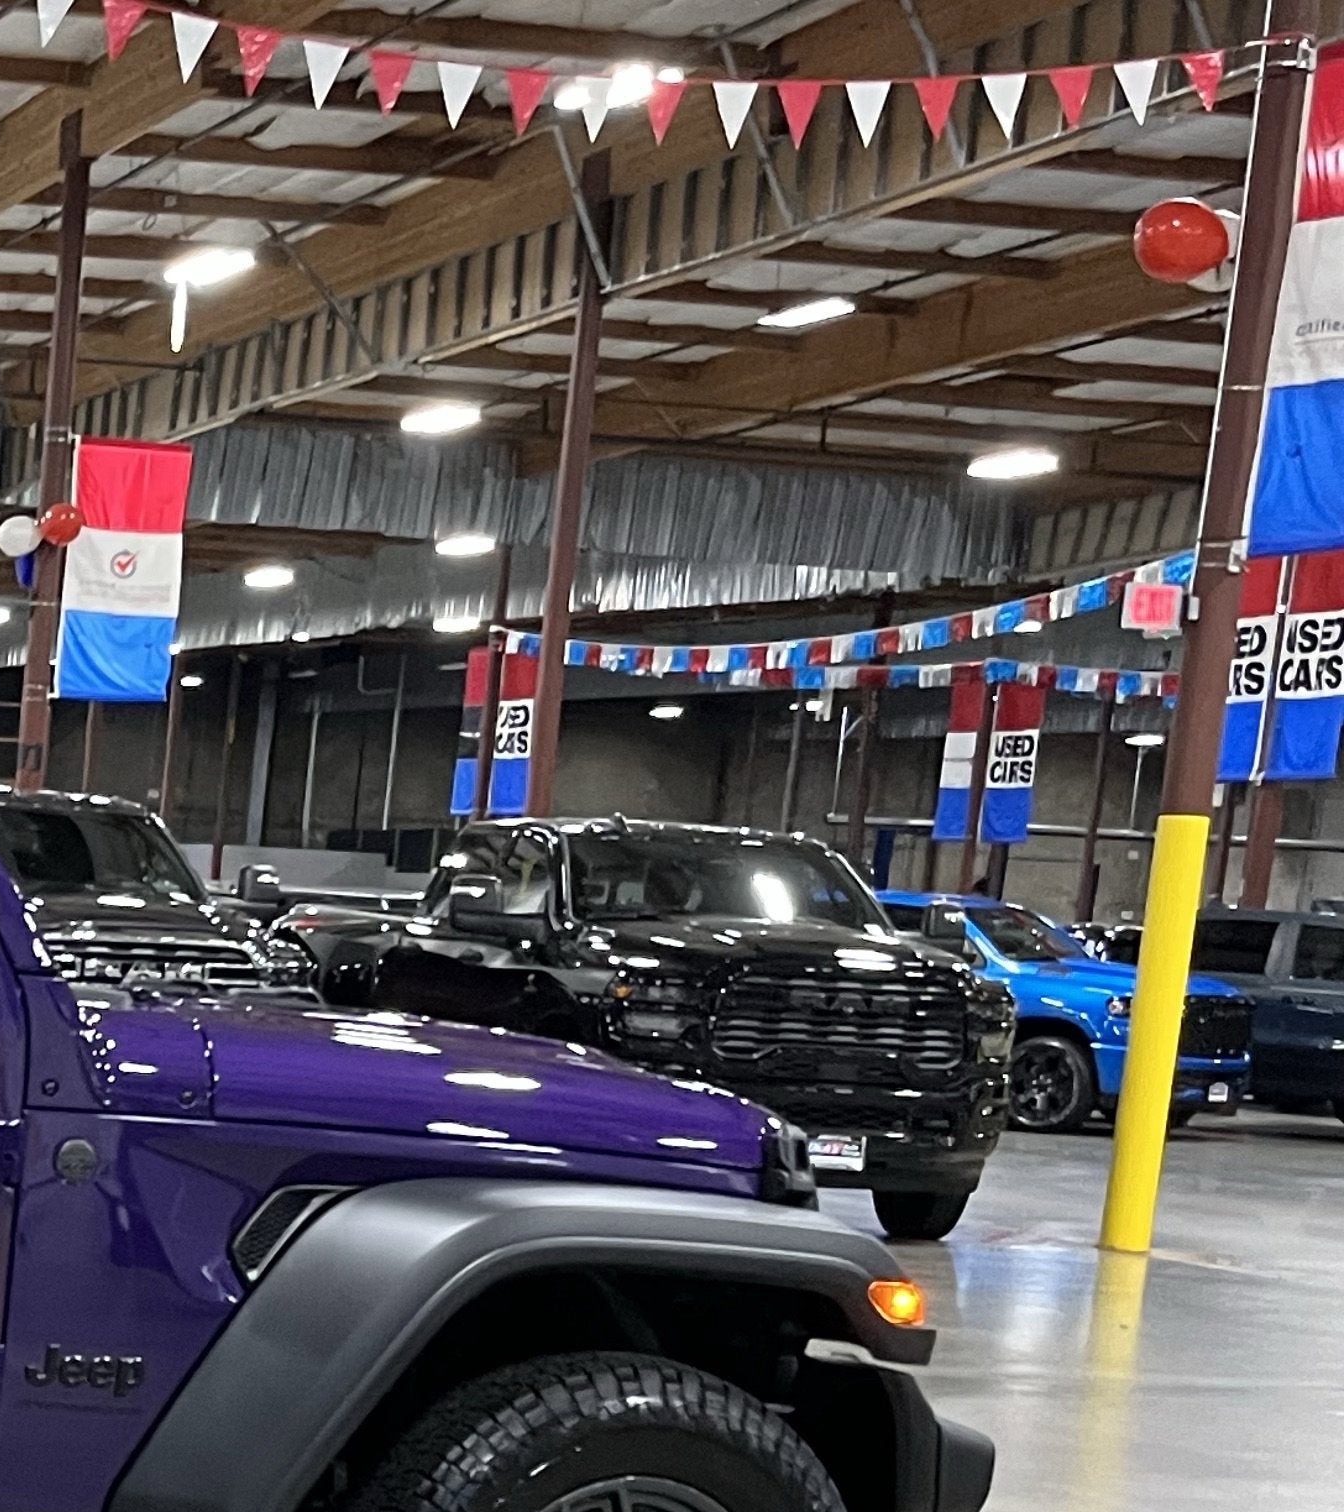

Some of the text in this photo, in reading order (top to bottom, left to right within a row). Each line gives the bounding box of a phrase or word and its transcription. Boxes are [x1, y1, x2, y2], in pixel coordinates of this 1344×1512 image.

[1236, 624, 1267, 659] ED
[1232, 662, 1266, 696] RS
[24, 1343, 145, 1398] Jeep
